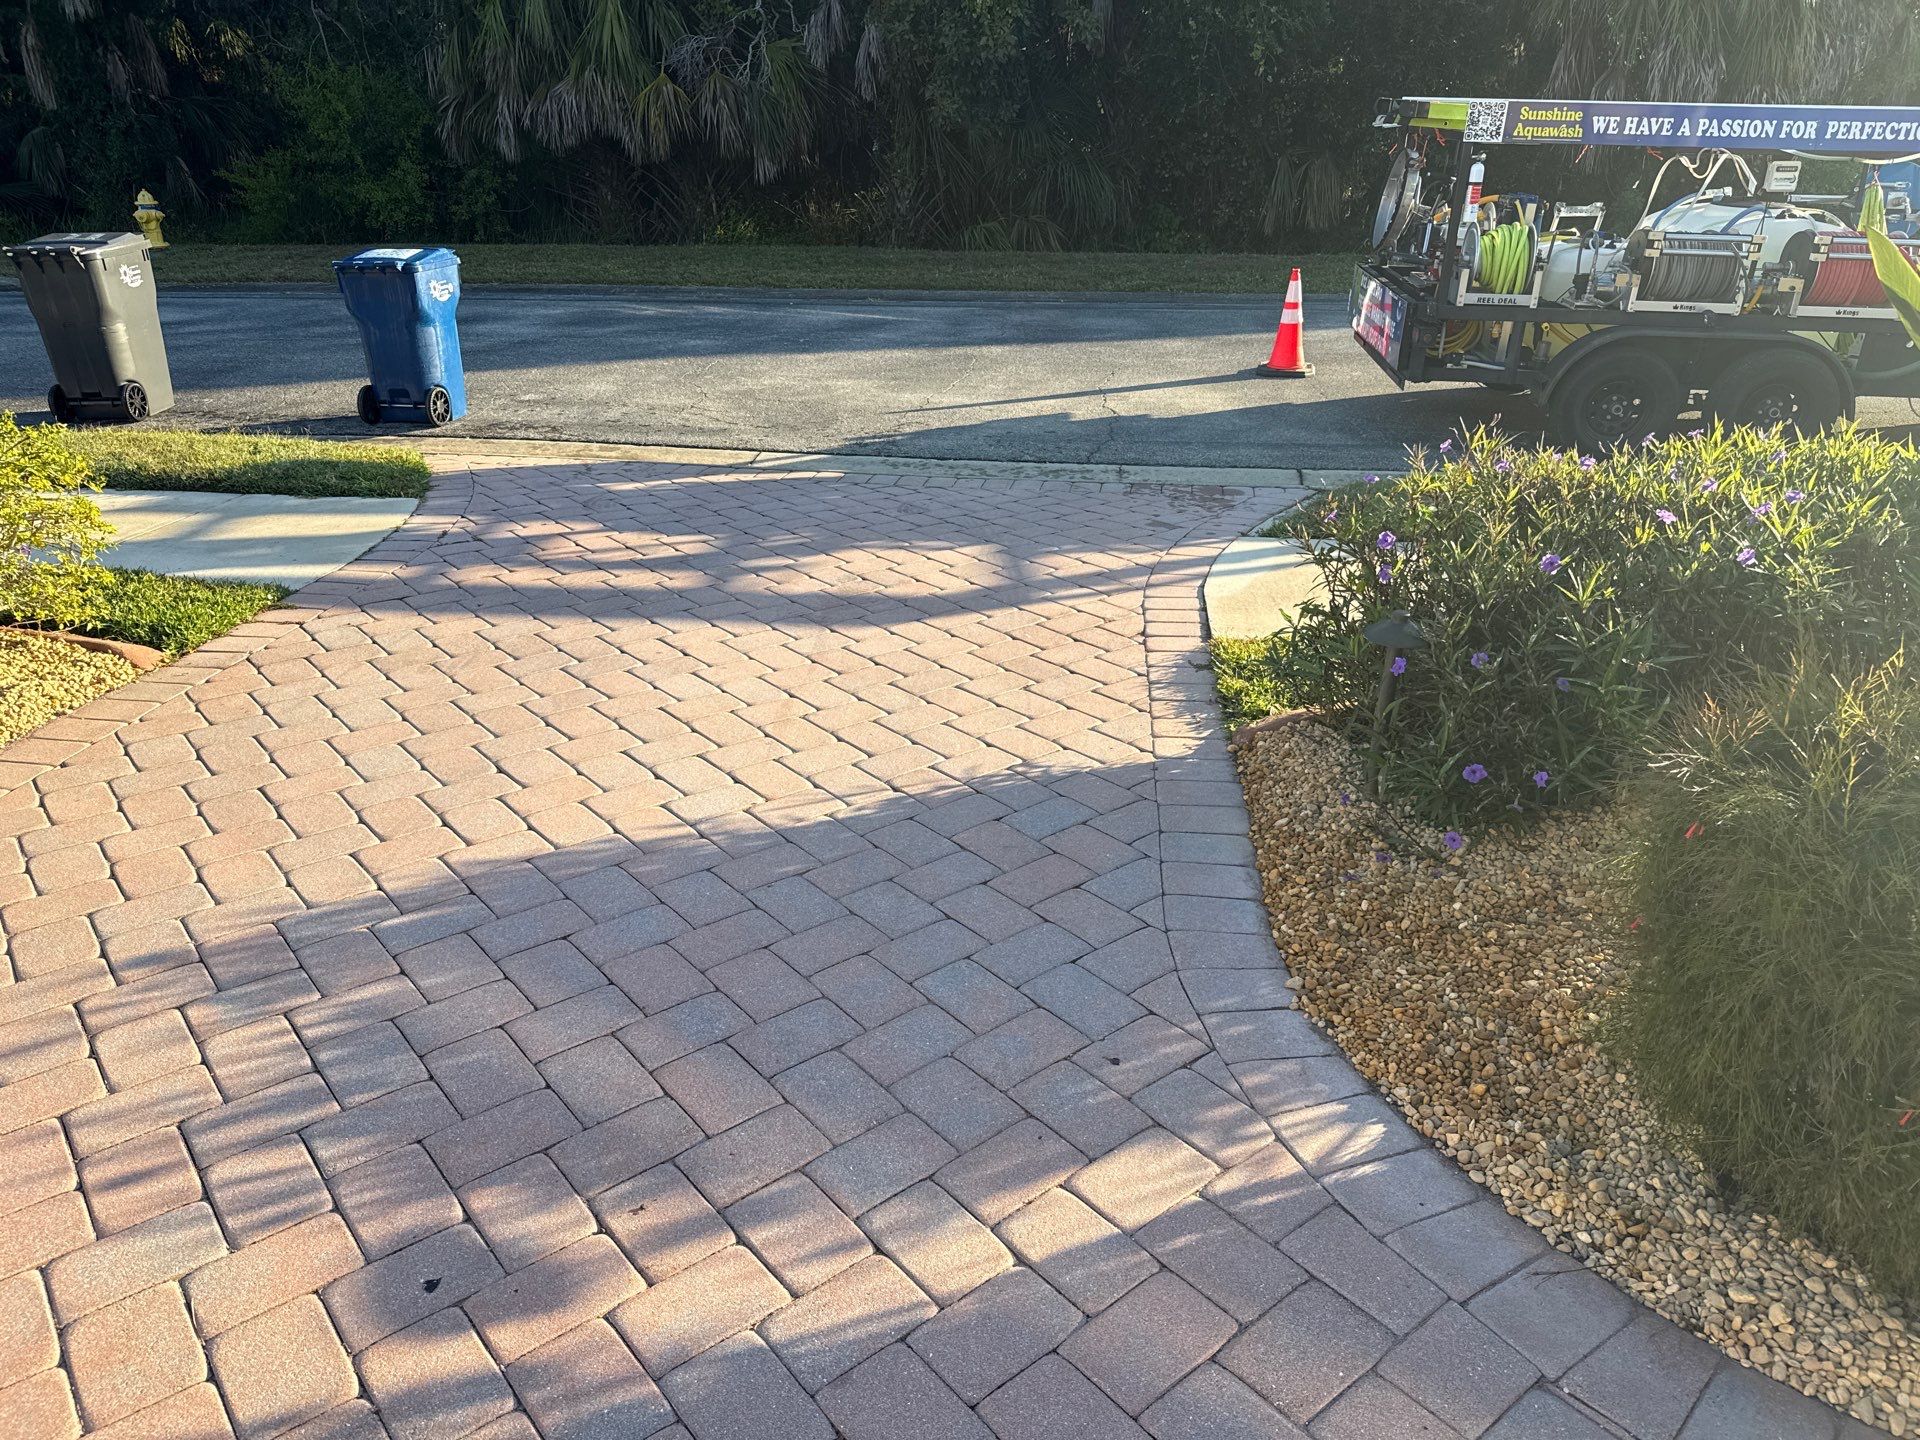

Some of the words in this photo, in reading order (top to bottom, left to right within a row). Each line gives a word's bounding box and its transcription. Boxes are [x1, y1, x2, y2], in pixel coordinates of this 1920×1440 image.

[1520, 106, 1583, 121] Sunshine
[1513, 123, 1583, 140] Aquawash
[1592, 116, 1620, 134] WE
[1623, 117, 1674, 136] HAVE
[1677, 118, 1690, 136] A
[1696, 118, 1777, 138] PASSION
[1779, 120, 1816, 139] FOR
